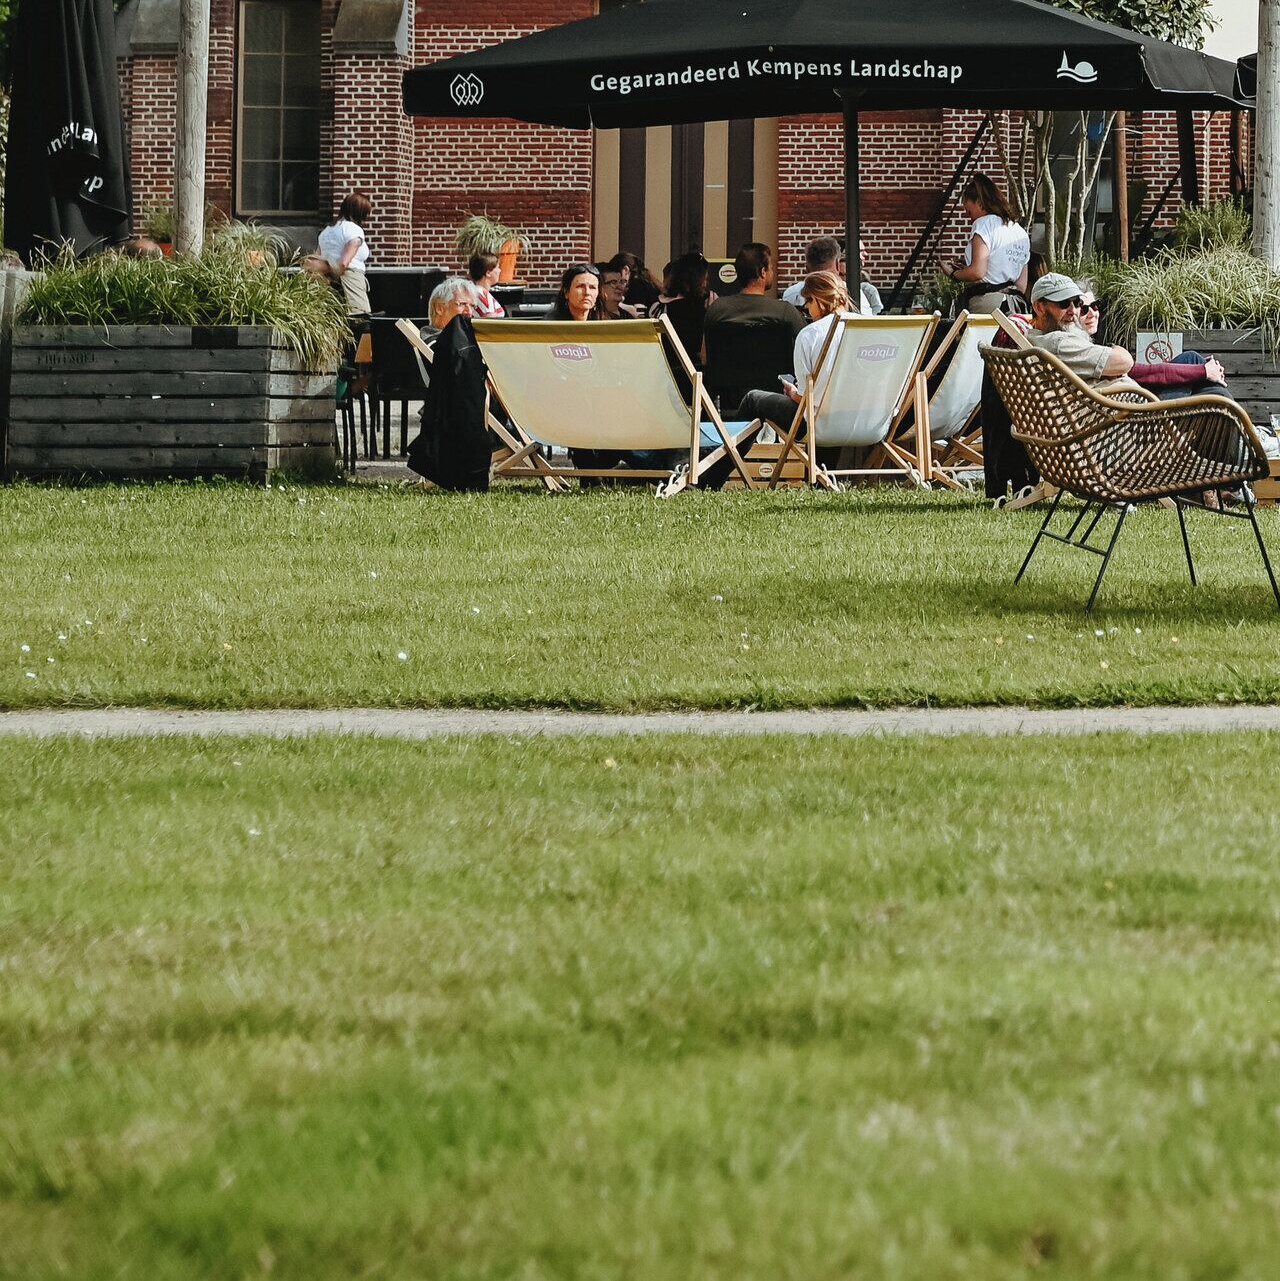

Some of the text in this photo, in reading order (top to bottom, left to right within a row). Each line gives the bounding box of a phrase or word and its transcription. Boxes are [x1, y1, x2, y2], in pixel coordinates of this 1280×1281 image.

[590, 59, 963, 95] Gegarandeerd Kempens Landschap
